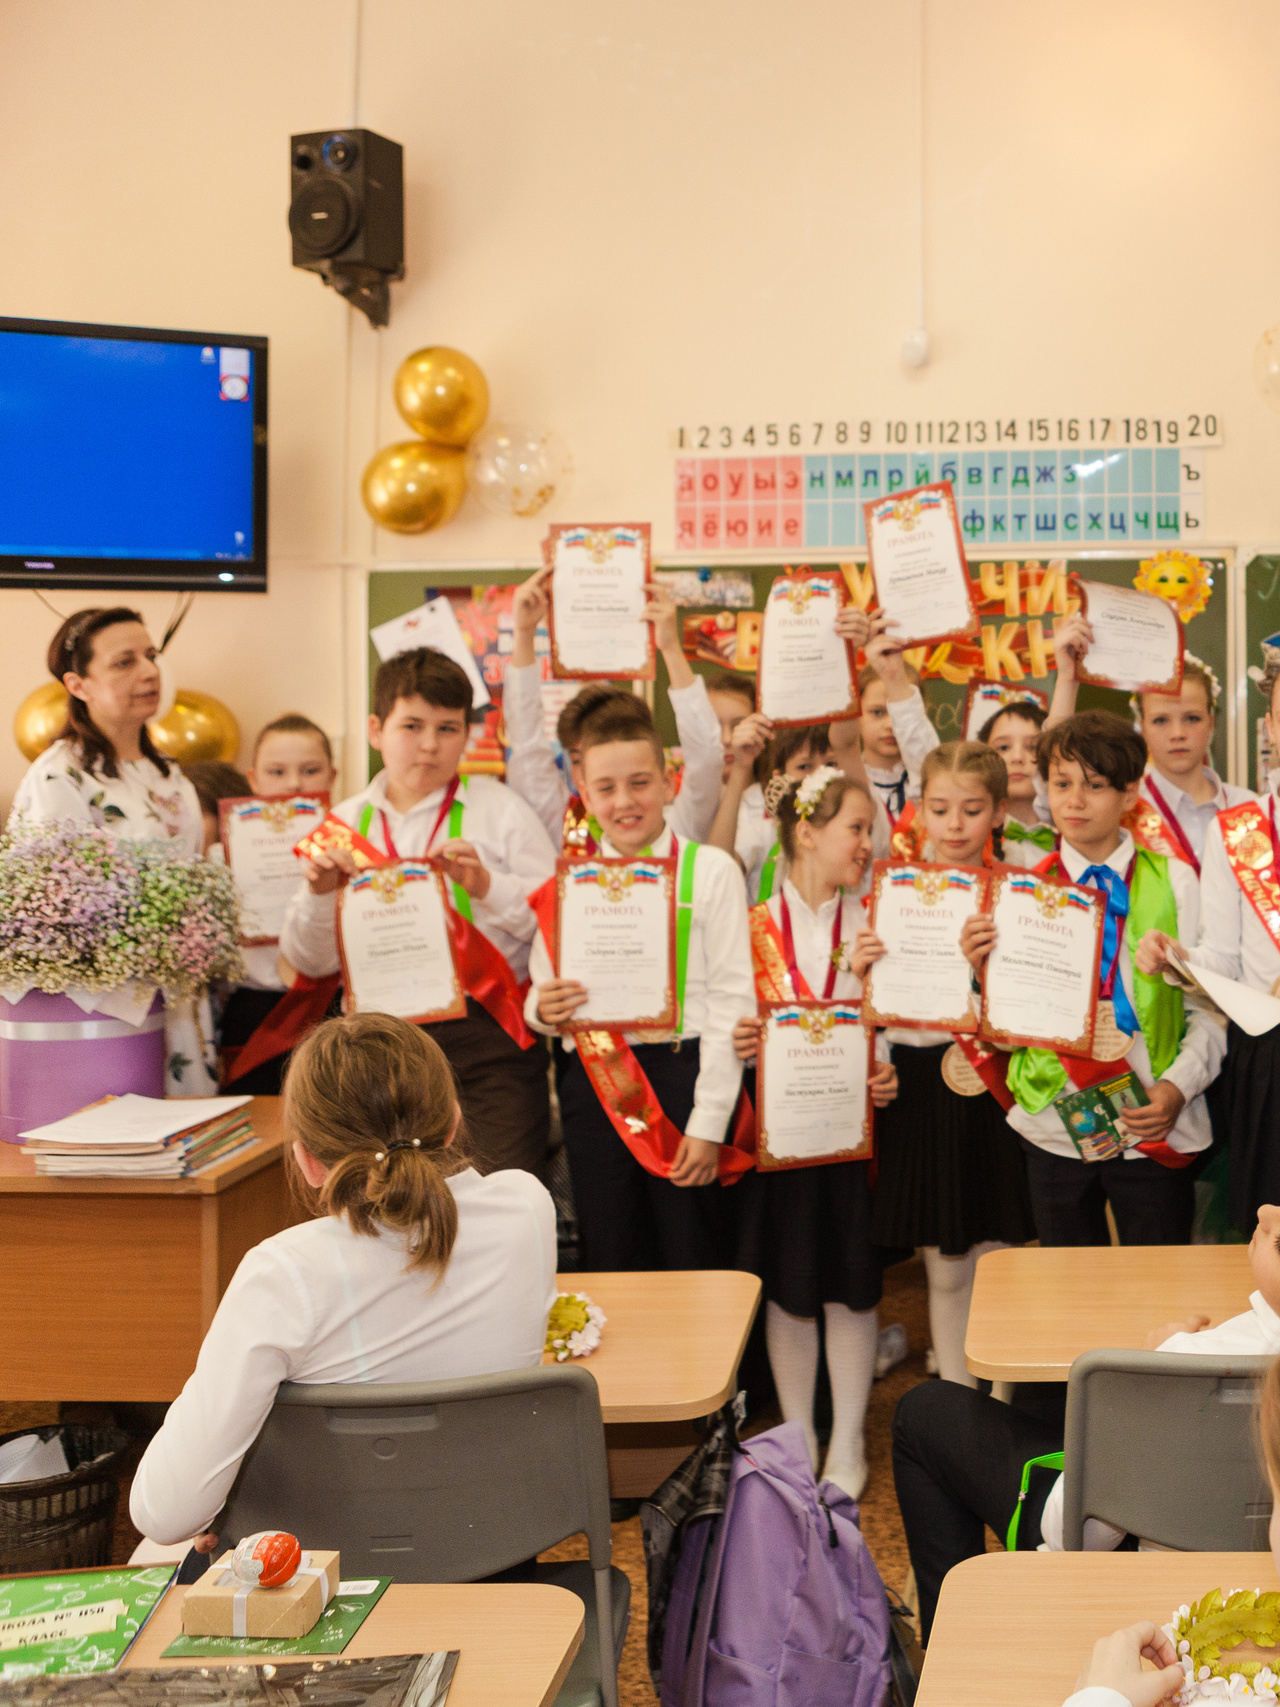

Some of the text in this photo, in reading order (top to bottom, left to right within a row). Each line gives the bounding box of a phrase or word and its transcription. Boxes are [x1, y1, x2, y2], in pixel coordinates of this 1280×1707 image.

[677, 414, 1218, 449] 1 2 3 4 5 6 7 8 9 10 11 12 13 14 15 16 17 18 19 20
[702, 473, 719, 491] о
[730, 472, 745, 497] у
[754, 472, 778, 490] ы
[784, 470, 800, 489] э
[809, 470, 825, 489] н
[835, 469, 853, 487] м
[861, 468, 880, 488] л
[887, 467, 903, 492] р
[966, 467, 982, 485] в
[993, 466, 1005, 484] г
[1011, 465, 1031, 488] д
[1035, 465, 1056, 483] ж
[703, 514, 719, 538] ё
[726, 519, 749, 537] ю
[760, 518, 774, 536] и
[784, 517, 800, 536] е
[962, 508, 985, 539] ф
[992, 513, 1006, 532] к
[1013, 513, 1028, 531] т
[1035, 512, 1058, 532] ш
[1063, 513, 1078, 531] с
[1088, 512, 1103, 532] х
[1109, 512, 1126, 534] ц
[1134, 512, 1150, 530] ч
[1156, 511, 1180, 533] щ
[1185, 512, 1200, 531] ь
[584, 905, 645, 916] ГРАМОТА
[899, 907, 955, 919] ГРАМОТА
[1016, 914, 1075, 939] ГРАМОТА
[787, 1047, 846, 1060] ГРАМОТА
[18, 1629, 69, 1646] КЛАСС
